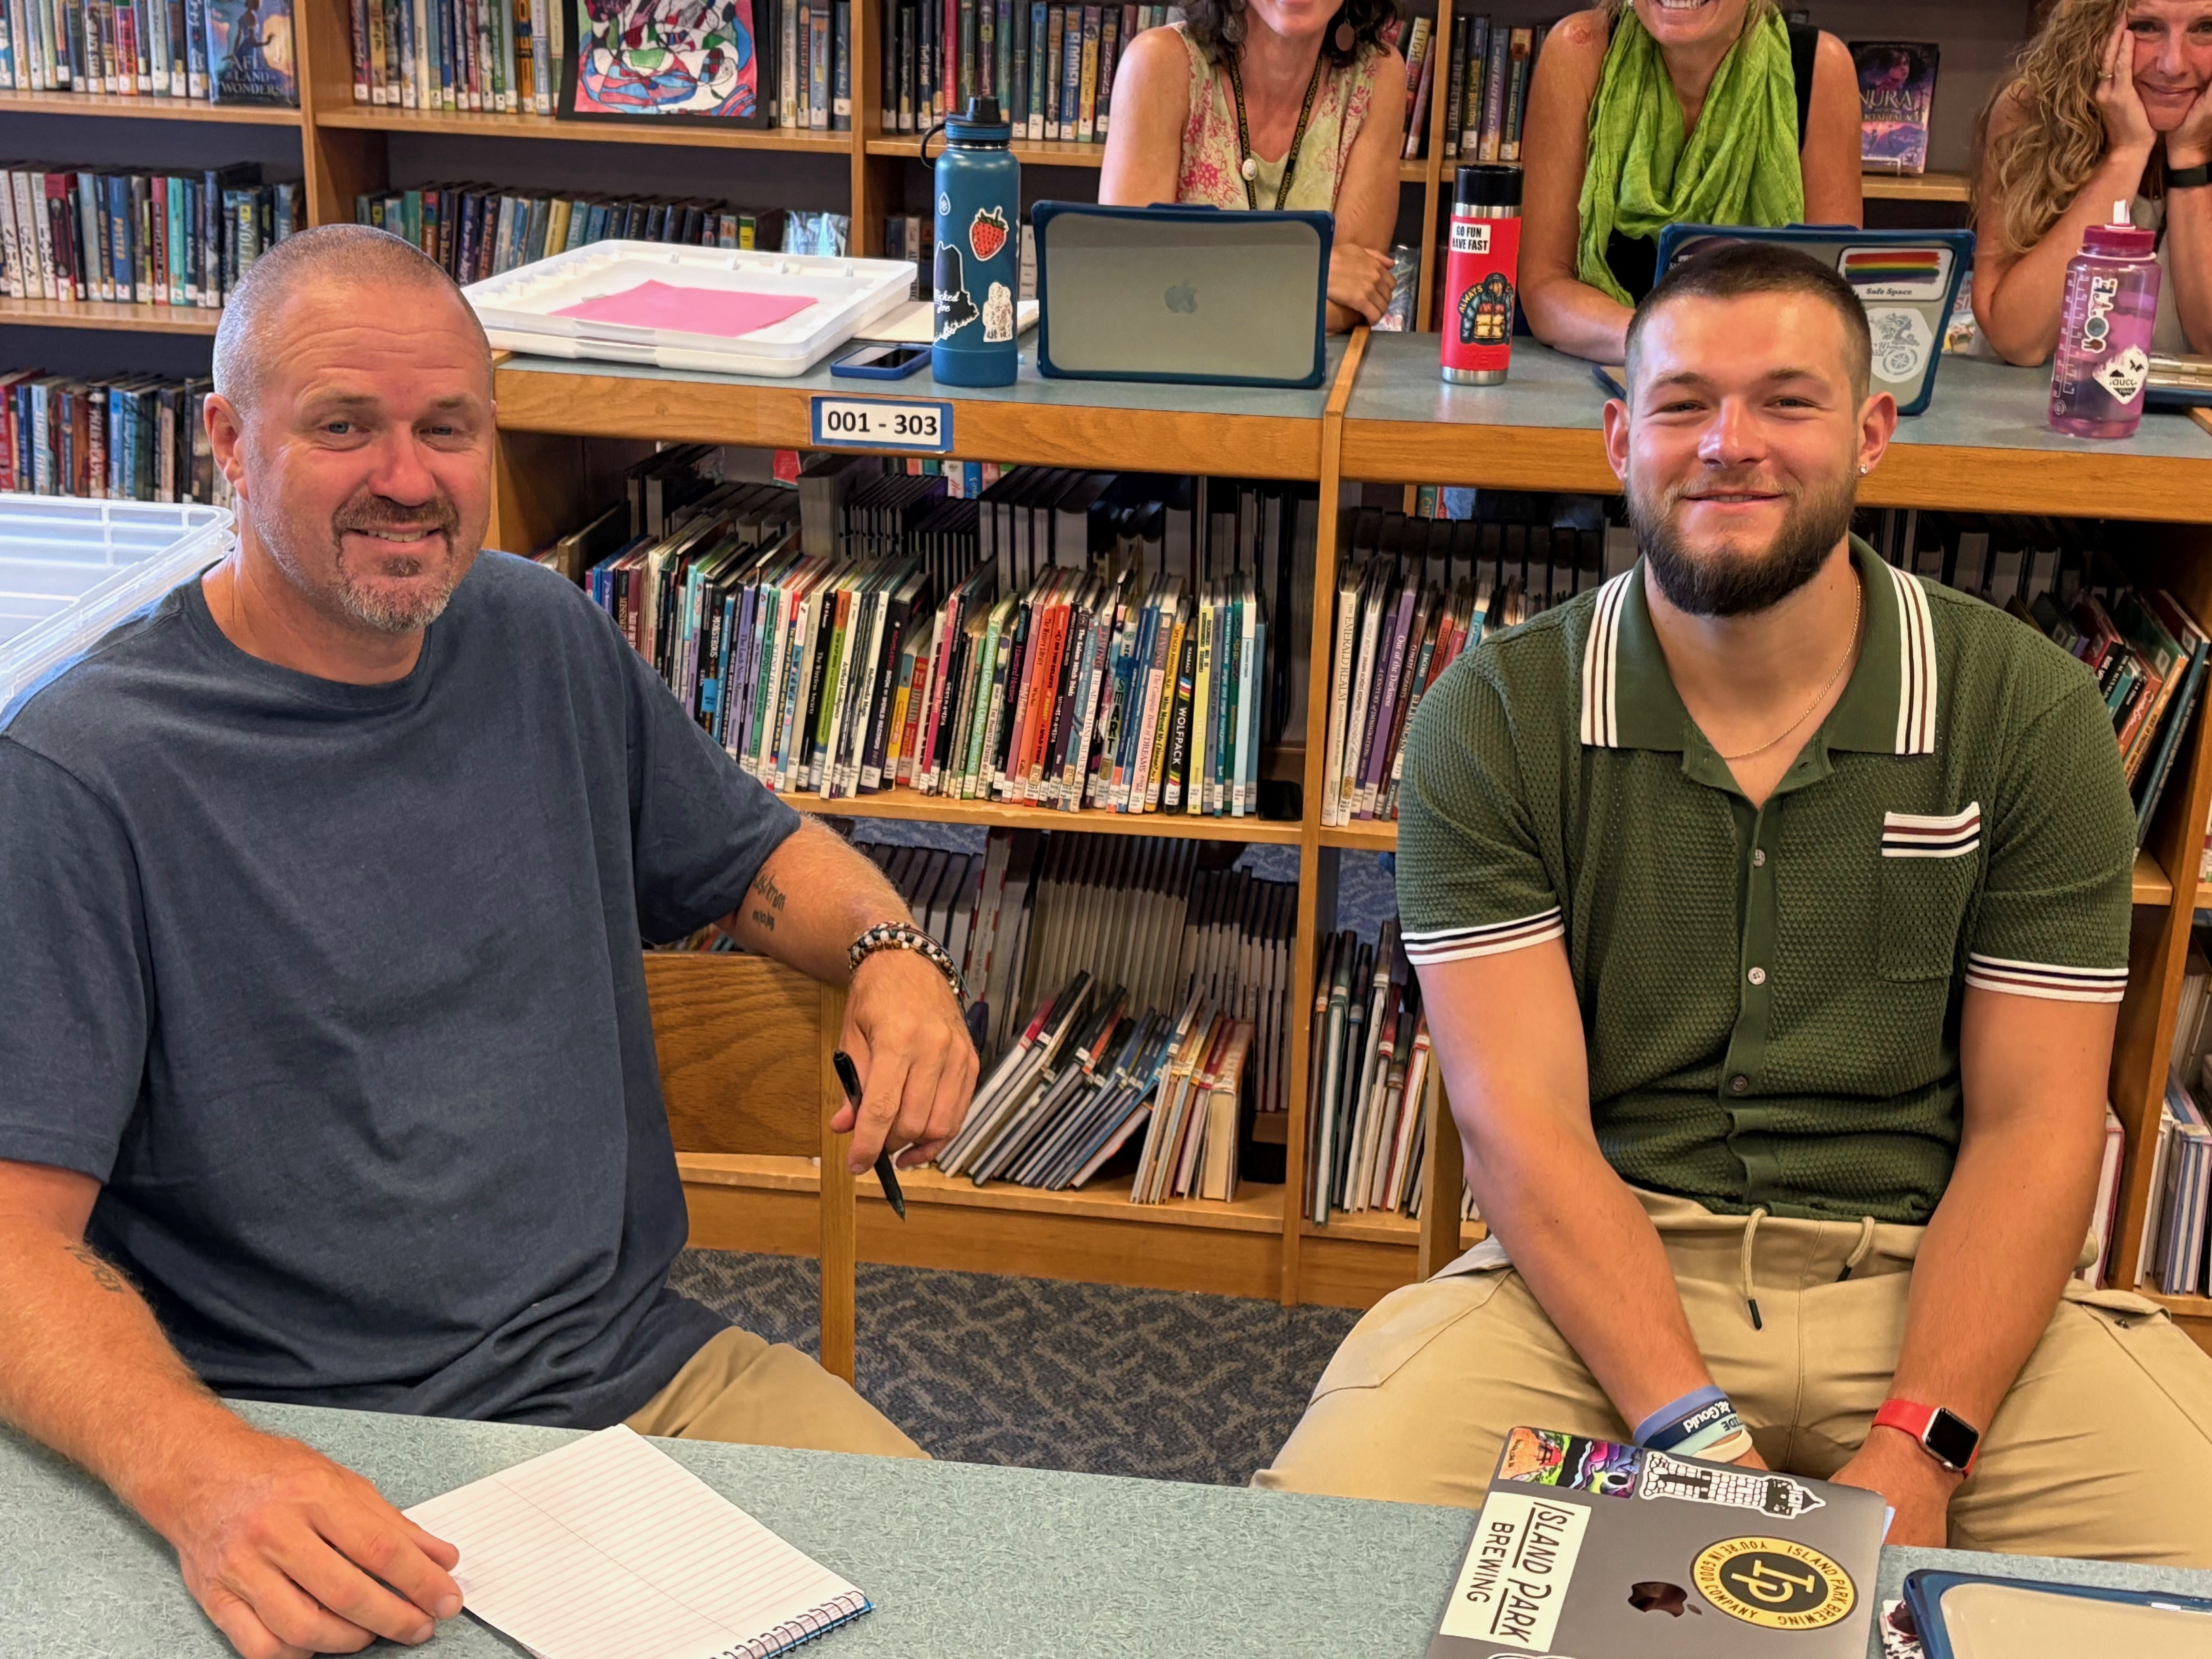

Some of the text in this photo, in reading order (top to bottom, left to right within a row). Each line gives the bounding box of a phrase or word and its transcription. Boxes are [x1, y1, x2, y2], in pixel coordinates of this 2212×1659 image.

[221, 81, 282, 96] WONDERS
[1490, 74, 1499, 96] BLACK
[1489, 98, 1498, 118] GIRLS
[1467, 227, 1482, 238] FUN
[1468, 240, 1488, 251] FAST
[1459, 285, 1483, 313] ALWAYS
[828, 411, 871, 432] 001
[894, 414, 937, 436] 303
[709, 616, 721, 658] MONSTROUS
[984, 631, 998, 670] Amazing
[1074, 641, 1082, 660] Salem
[1094, 631, 1108, 669] LIVING
[1154, 630, 1168, 668] LIVING
[1171, 629, 1180, 651] SPENCER
[1341, 616, 1353, 665] EMERALD
[1395, 634, 1405, 651] Out
[762, 643, 771, 673] BIGFOOT
[1036, 647, 1046, 665] Library
[1183, 646, 1194, 673] WAMBACH
[1391, 661, 1400, 673] the
[1394, 651, 1402, 661] of
[1417, 653, 1430, 678] JACOBS
[766, 643, 779, 711] SCIENCE OF CHAOS
[807, 651, 824, 714] The Wireless Society
[883, 670, 892, 688] BOOK
[1008, 645, 1022, 703] Haunted Houses
[1047, 664, 1056, 689] BELIEVE
[1071, 661, 1079, 679] Witch
[1153, 673, 1161, 685] The
[1399, 644, 1417, 699] CLIMATE MIGRANTS
[833, 661, 848, 720] Artificial Intelligence
[864, 668, 874, 700] Multimedia
[980, 670, 992, 700] Ghosts
[1338, 667, 1349, 702] REALM
[1372, 674, 1383, 704] CENTURY
[1384, 674, 1398, 708] Darkness
[878, 696, 888, 719] WORLD
[1082, 672, 1101, 742] THE ART OF HAND
[1147, 686, 1160, 712] Complete
[1407, 694, 1420, 721] ELLIS
[872, 720, 884, 749] RECORDS
[975, 709, 986, 733] Other
[986, 720, 995, 742] HAUNTED
[1146, 714, 1155, 729] Book
[1158, 711, 1167, 732] Moved
[1362, 711, 1377, 757] IMMIGRATION:
[1156, 733, 1163, 742] My
[1171, 706, 1188, 765] WOLFPACK
[2133, 733, 2148, 754] FREEDOM
[968, 734, 982, 773] Mysteries
[1137, 737, 1152, 772] DREAMS
[1151, 743, 1163, 769] Cheese?
[1683, 1406, 1720, 1433] Gould
[1467, 1522, 1515, 1603] BREWING
[1707, 1550, 1724, 1561] IN
[1498, 1502, 1575, 1643] ISLAND PARK
[1700, 1561, 1717, 1581] GOOD
[1778, 1545, 1848, 1626] ISLAND PARK BREWING
[1705, 1585, 1759, 1619] COMPANY
